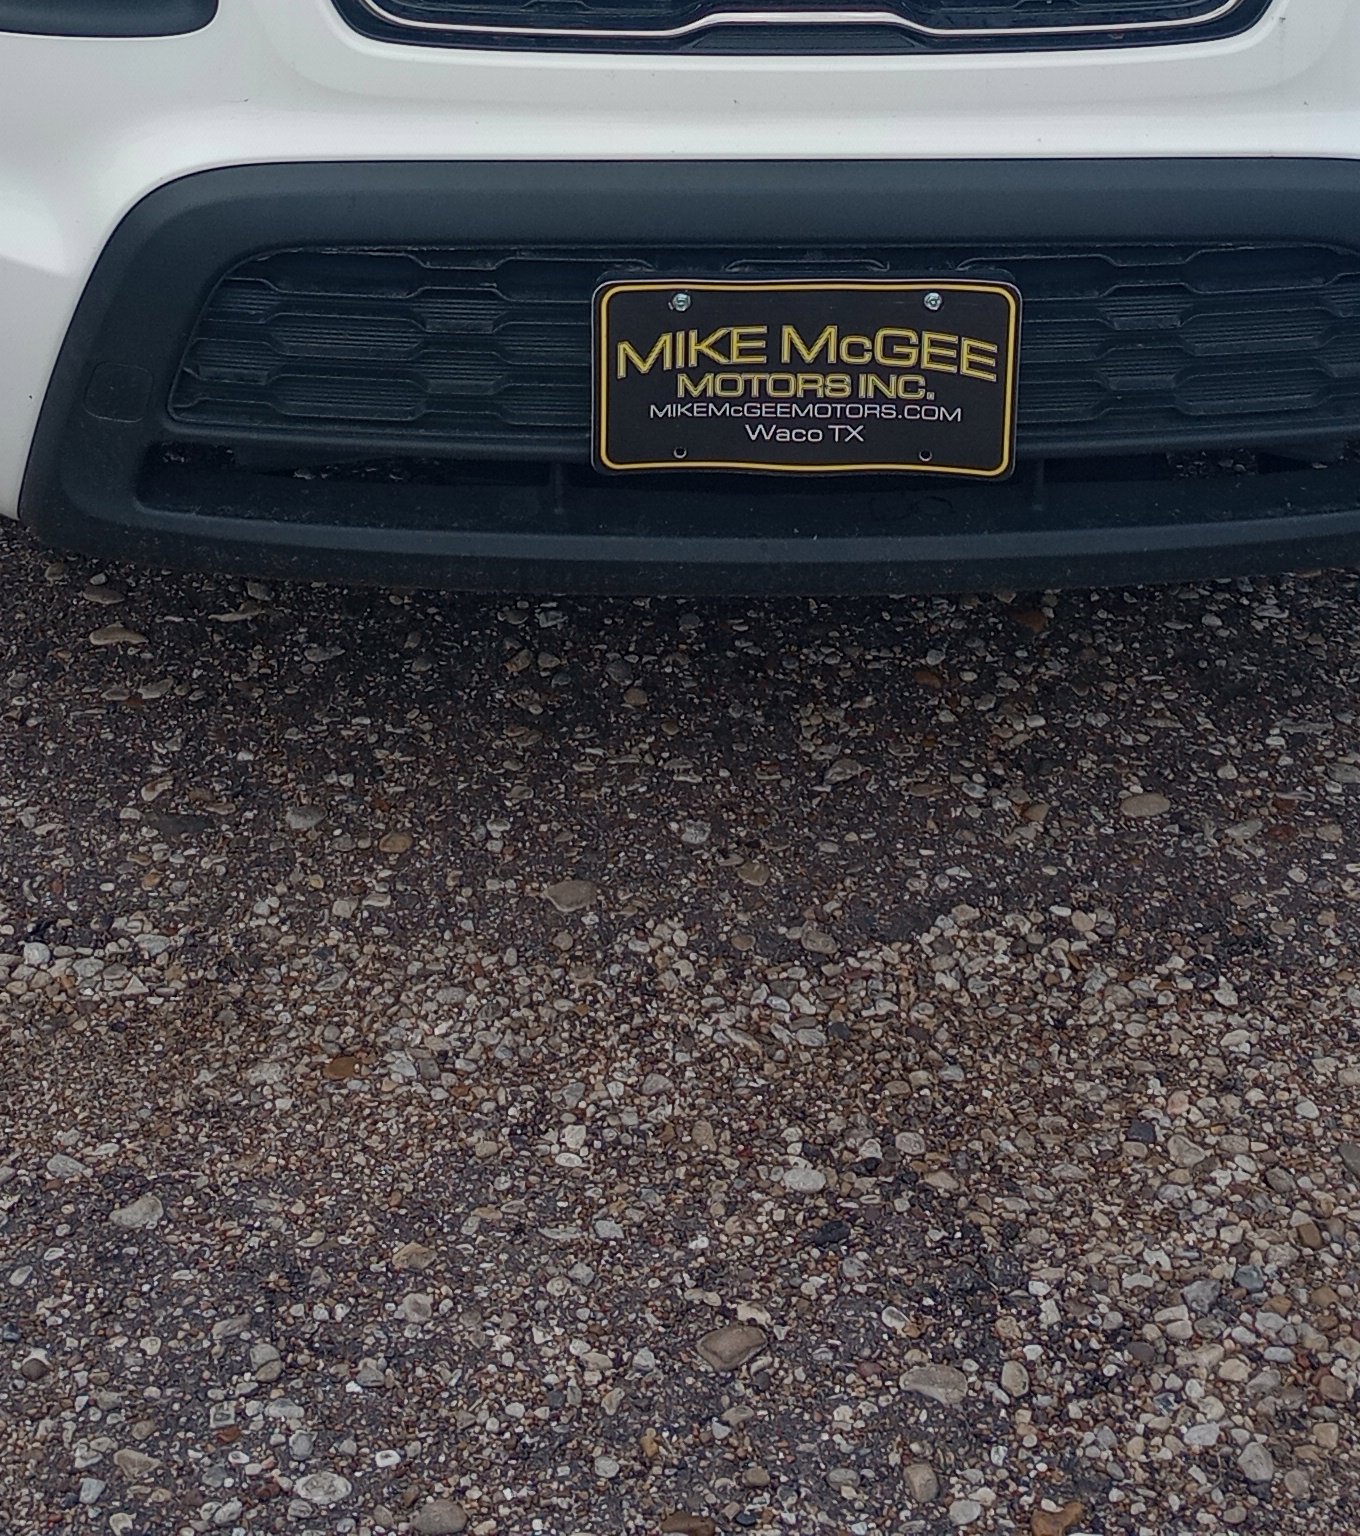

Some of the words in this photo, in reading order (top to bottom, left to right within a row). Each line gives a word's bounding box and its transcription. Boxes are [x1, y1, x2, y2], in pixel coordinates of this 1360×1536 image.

[616, 325, 769, 379] MIKE
[780, 324, 999, 383] McGEE
[676, 372, 853, 399] MOTORS
[859, 373, 936, 401] INC.
[649, 402, 963, 422] MIKEMcGEEMOTORS.COM
[745, 424, 824, 443] Waco
[828, 424, 866, 443] TX
